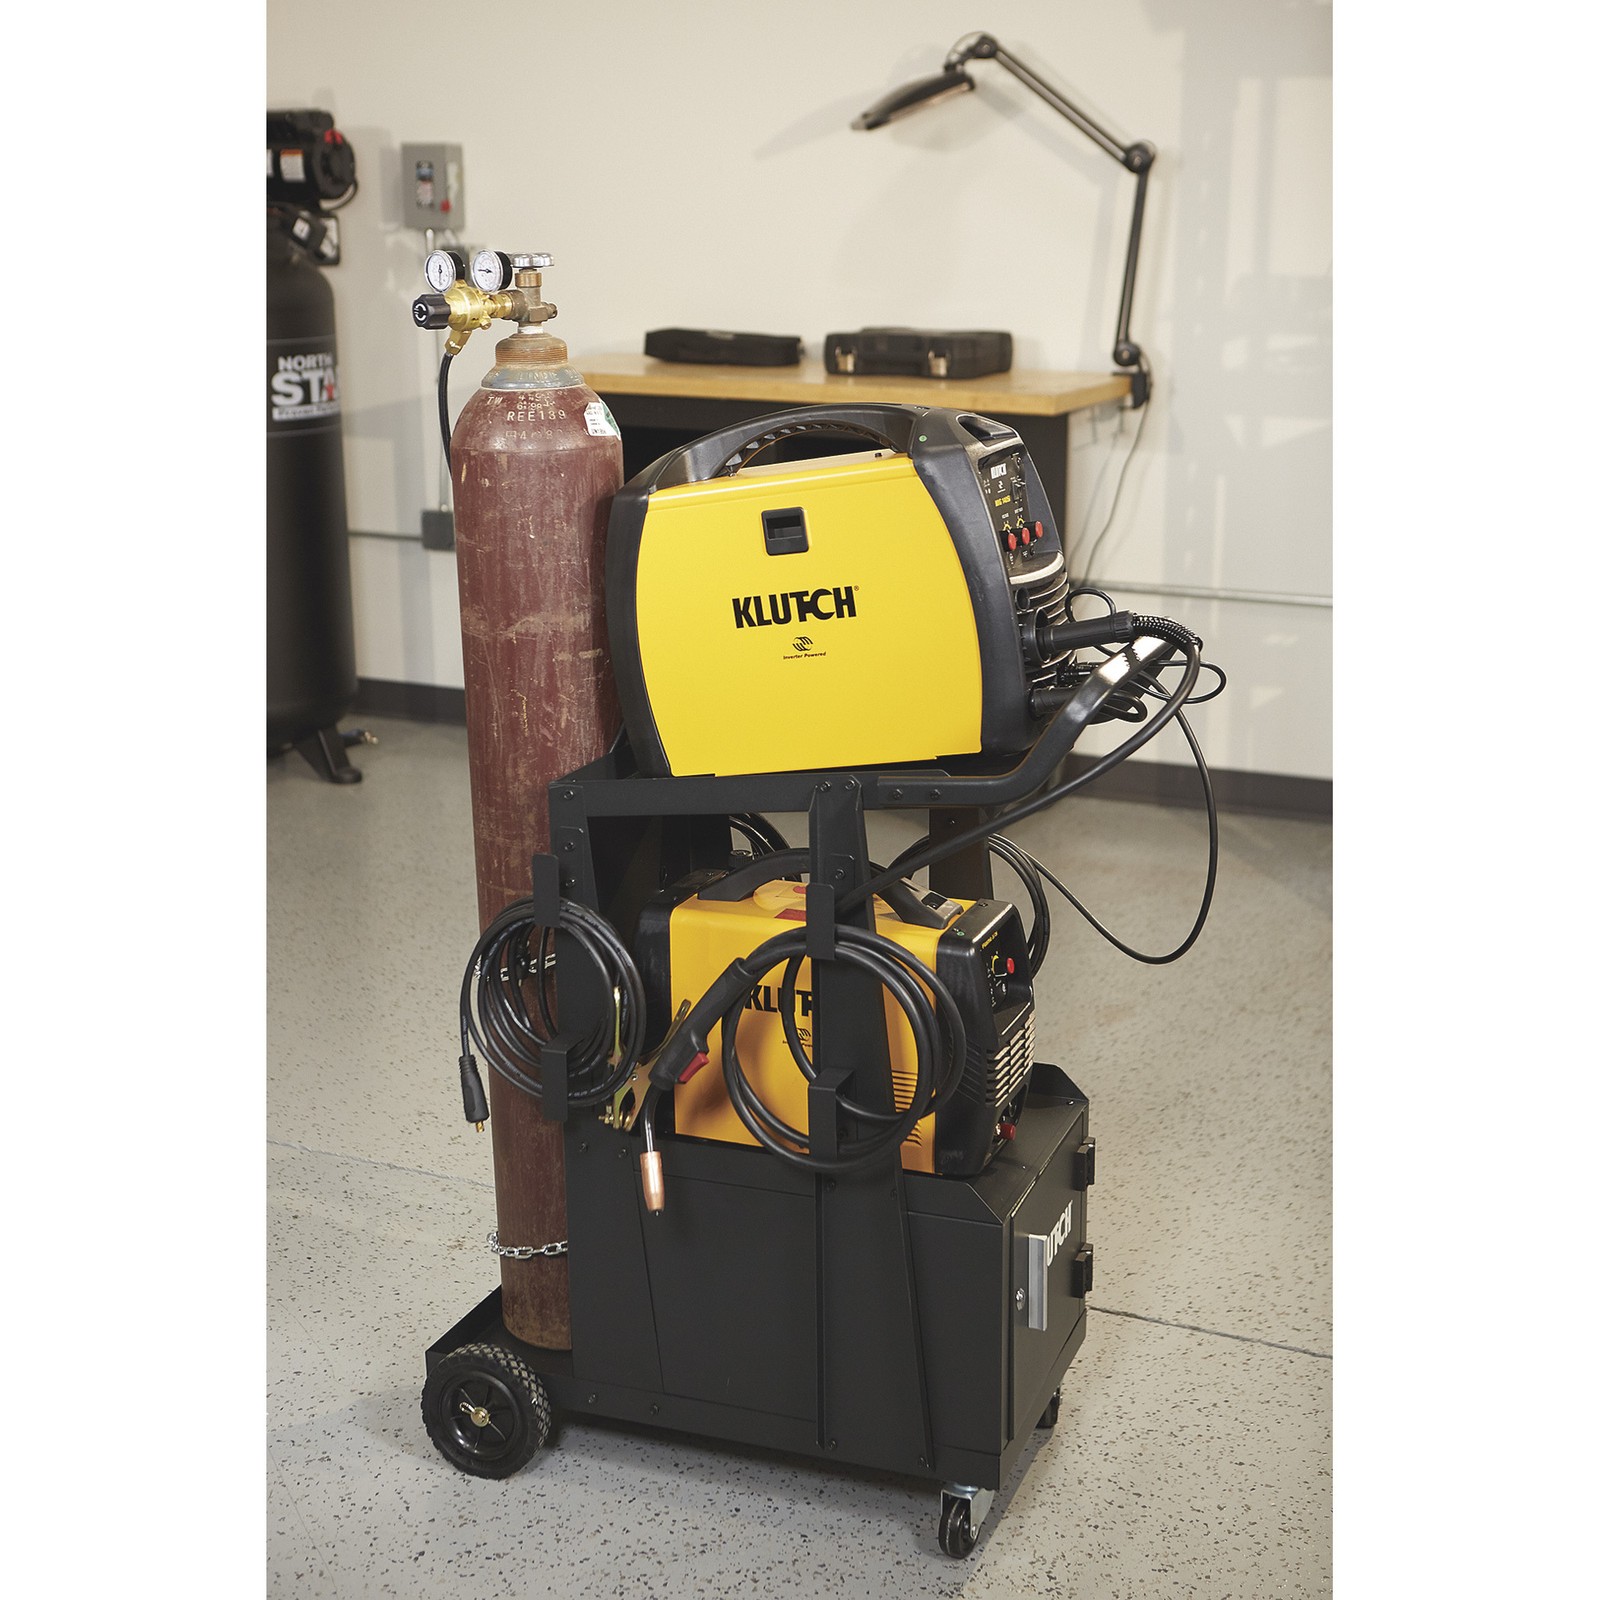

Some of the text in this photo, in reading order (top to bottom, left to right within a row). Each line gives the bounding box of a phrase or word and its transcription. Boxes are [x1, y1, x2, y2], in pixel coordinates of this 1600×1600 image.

[277, 352, 333, 371] NORTH
[271, 367, 337, 406] STA
[507, 409, 566, 422] REE139
[1047, 1199, 1074, 1267] UTCH
